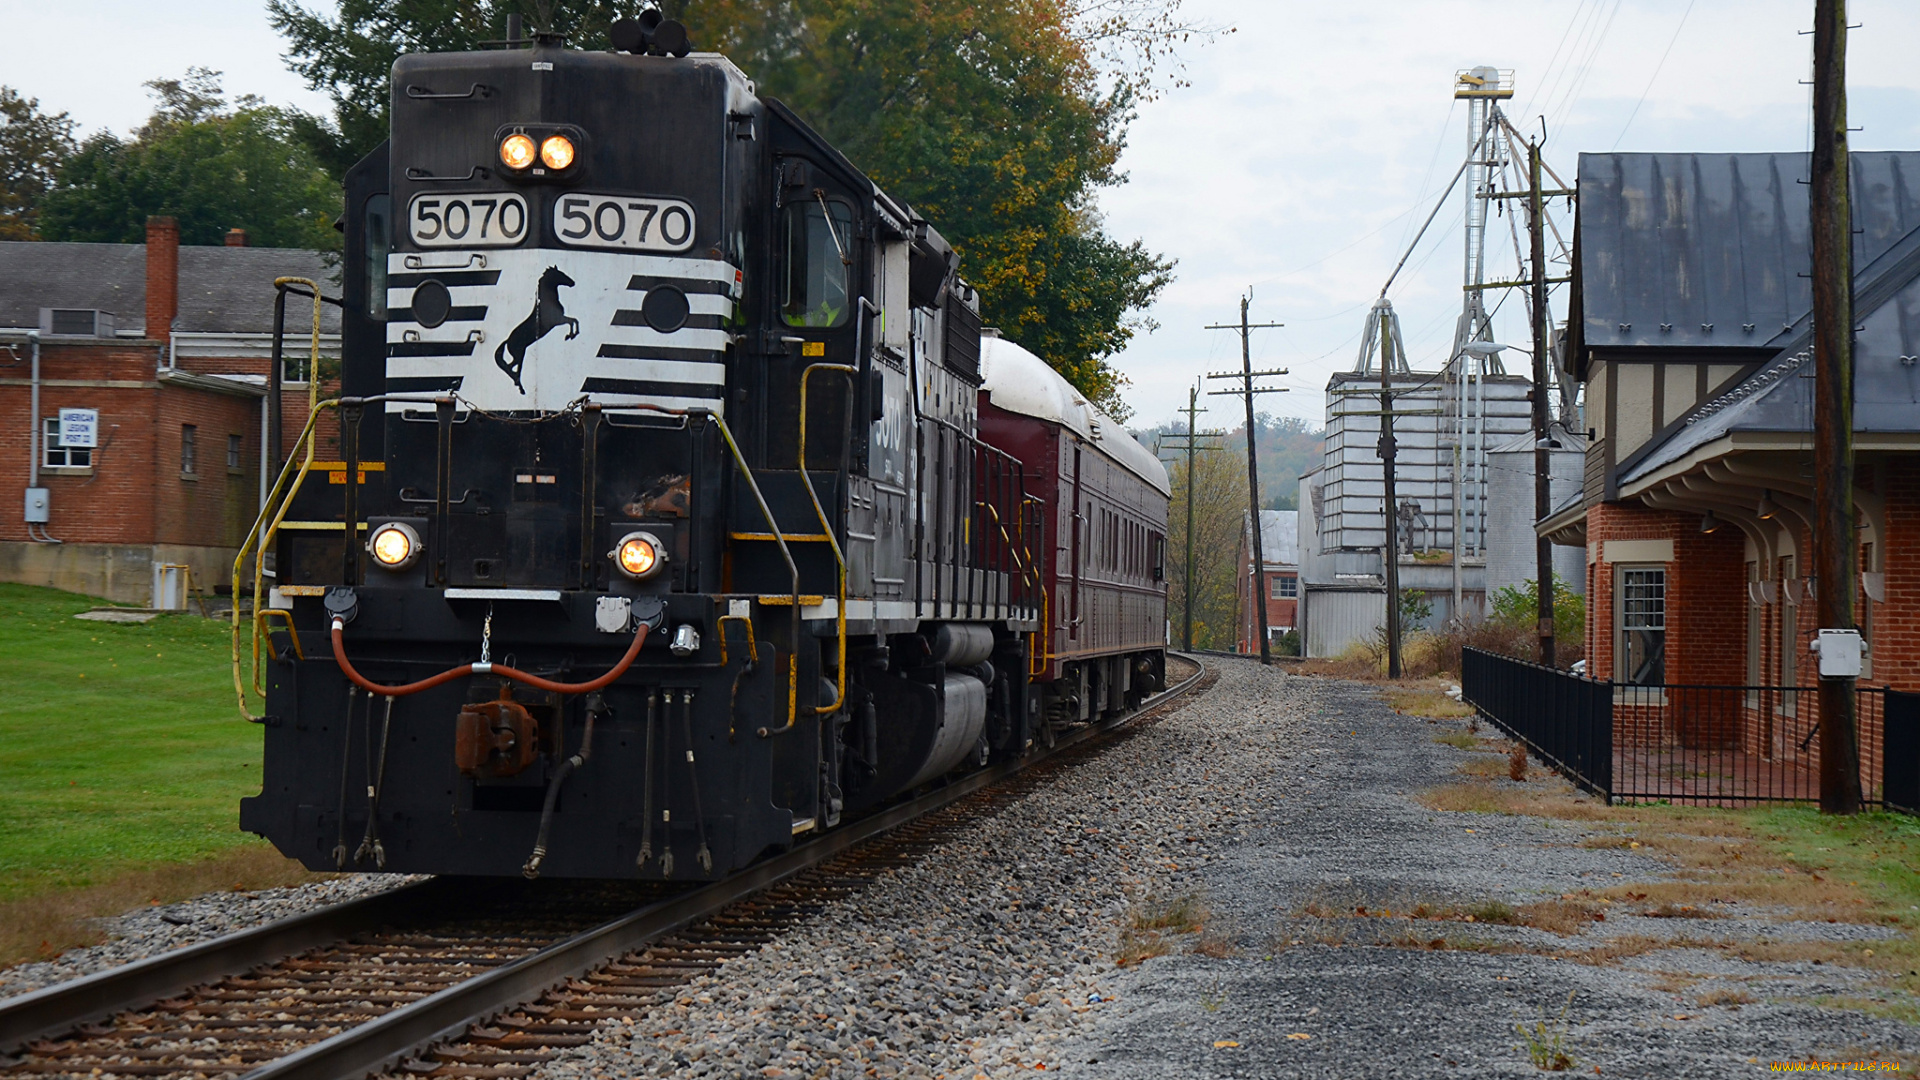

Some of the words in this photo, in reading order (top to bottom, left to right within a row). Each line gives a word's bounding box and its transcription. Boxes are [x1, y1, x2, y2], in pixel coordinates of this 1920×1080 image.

[416, 198, 526, 240] 5070
[561, 198, 692, 246] 5070
[63, 413, 94, 422] AMERICAN
[66, 423, 89, 432] LEGION
[65, 434, 81, 443] POST
